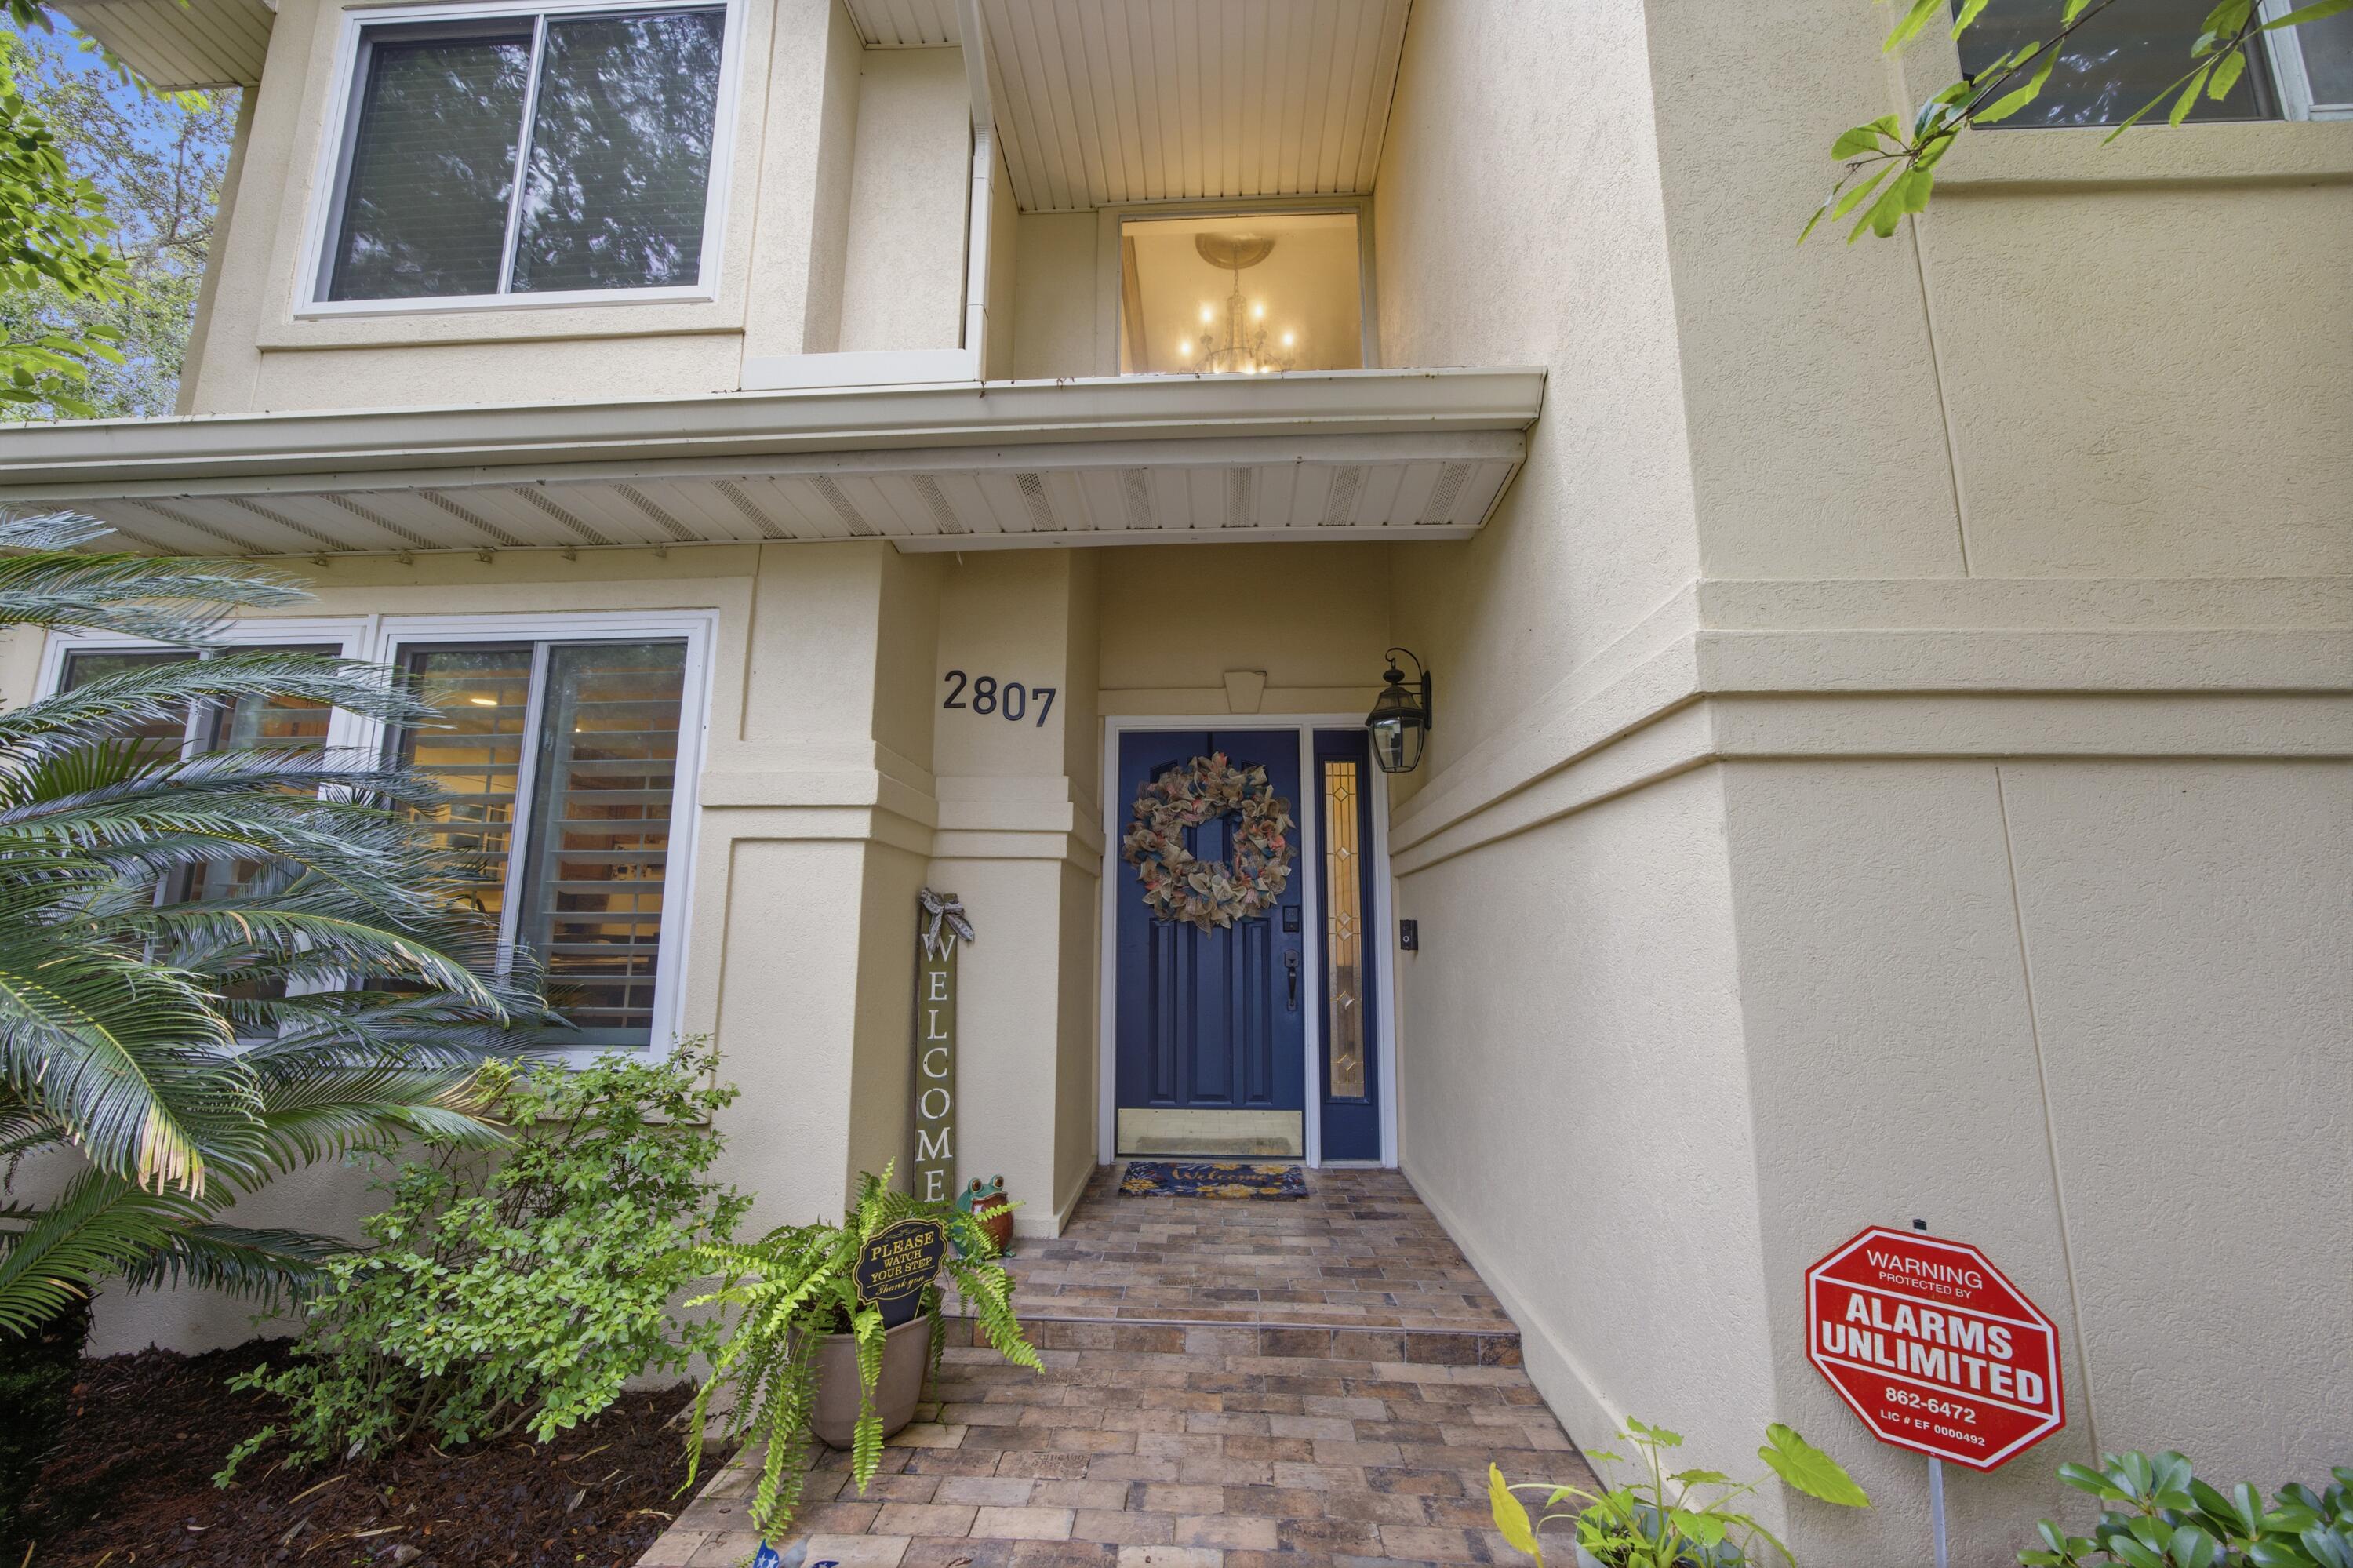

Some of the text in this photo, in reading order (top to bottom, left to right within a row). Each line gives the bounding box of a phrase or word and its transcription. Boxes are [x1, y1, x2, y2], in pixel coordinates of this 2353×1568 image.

[944, 670, 1056, 727] 2807
[915, 933, 956, 1202] WELCOME
[871, 1231, 934, 1261] PLEASE
[883, 1249, 922, 1268] WATCH
[871, 1256, 933, 1283] YOUR STEP
[875, 1279, 907, 1296] Thank
[1867, 1249, 1983, 1290] WARNING
[1878, 1271, 1972, 1299] PROTECTED BY
[1846, 1293, 2013, 1360] ALARMS
[1822, 1321, 2044, 1405] UNLIMITED
[1886, 1387, 1976, 1424] 862-6472
[1880, 1410, 1985, 1446] LIC # EF 0000492
